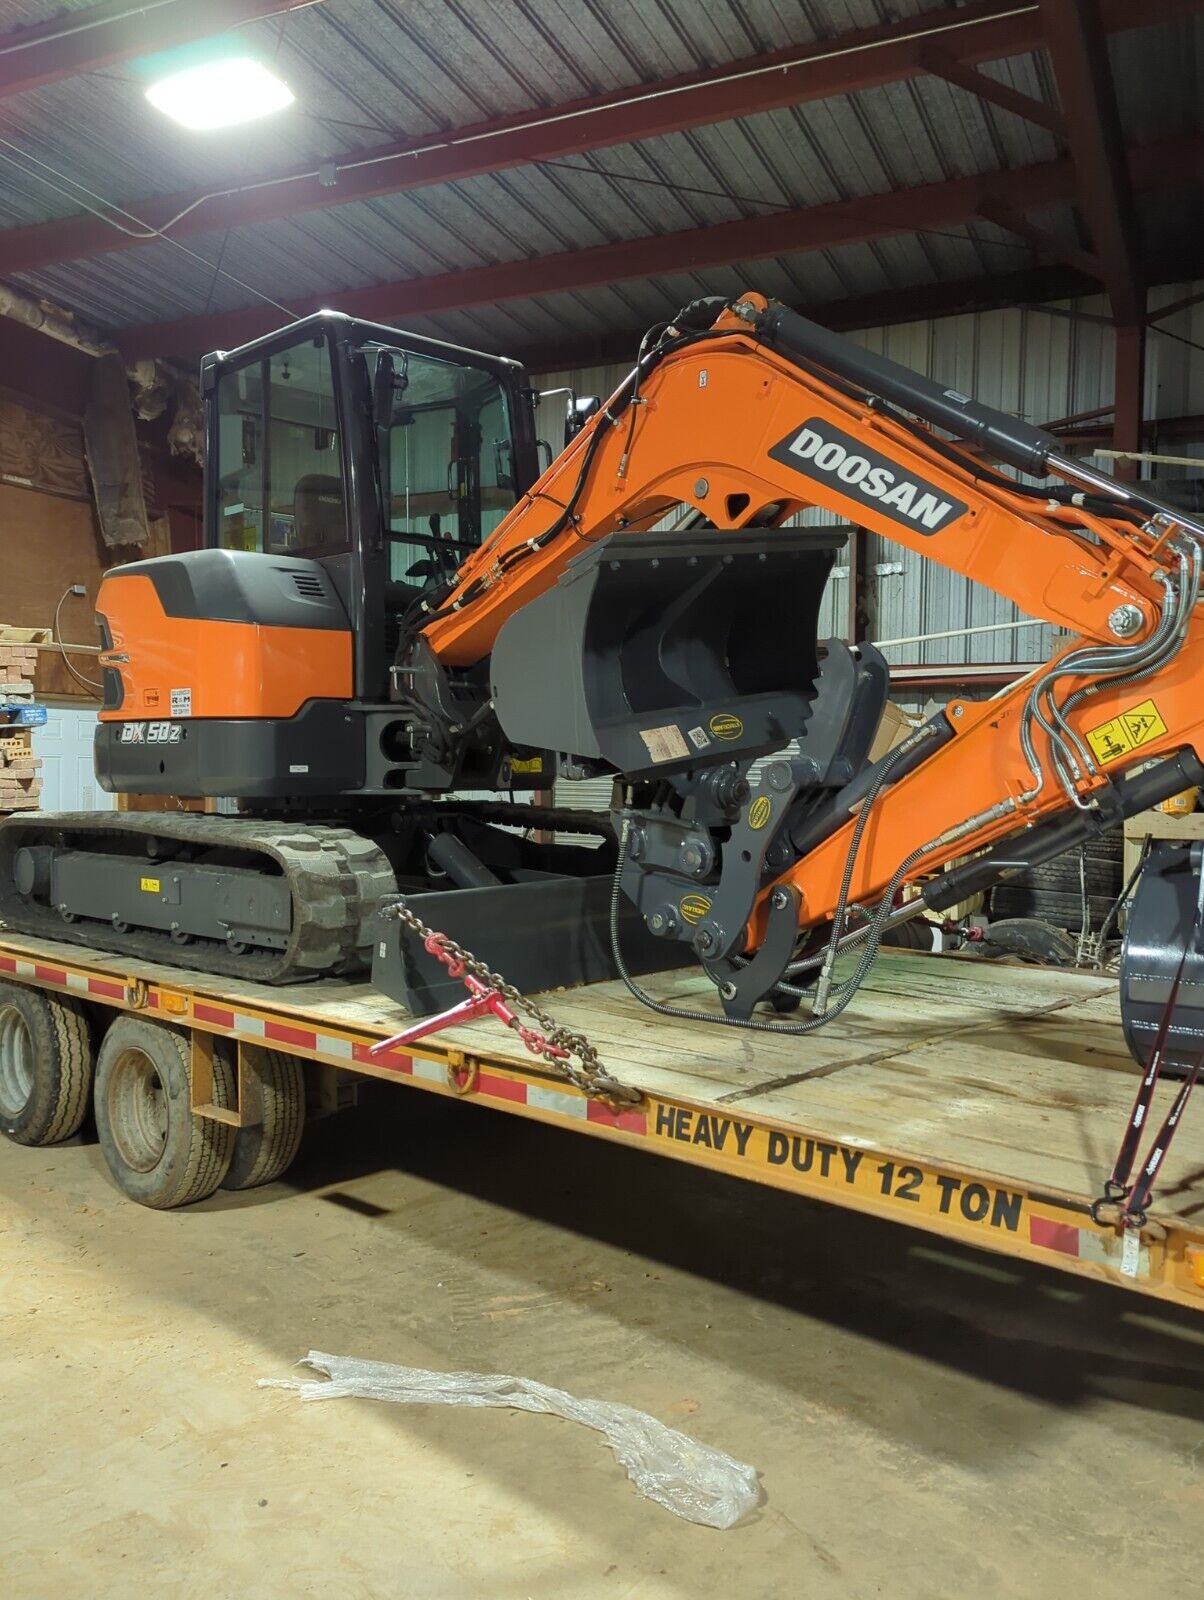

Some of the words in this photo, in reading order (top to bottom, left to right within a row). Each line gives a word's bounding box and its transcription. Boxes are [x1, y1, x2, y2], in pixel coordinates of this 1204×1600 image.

[789, 428, 953, 530] DOOSAN
[121, 722, 146, 744] DX
[655, 1104, 754, 1156] HEAVY
[768, 1131, 864, 1184] DUTY
[877, 1162, 924, 1202] 12
[936, 1175, 1023, 1232] TON
